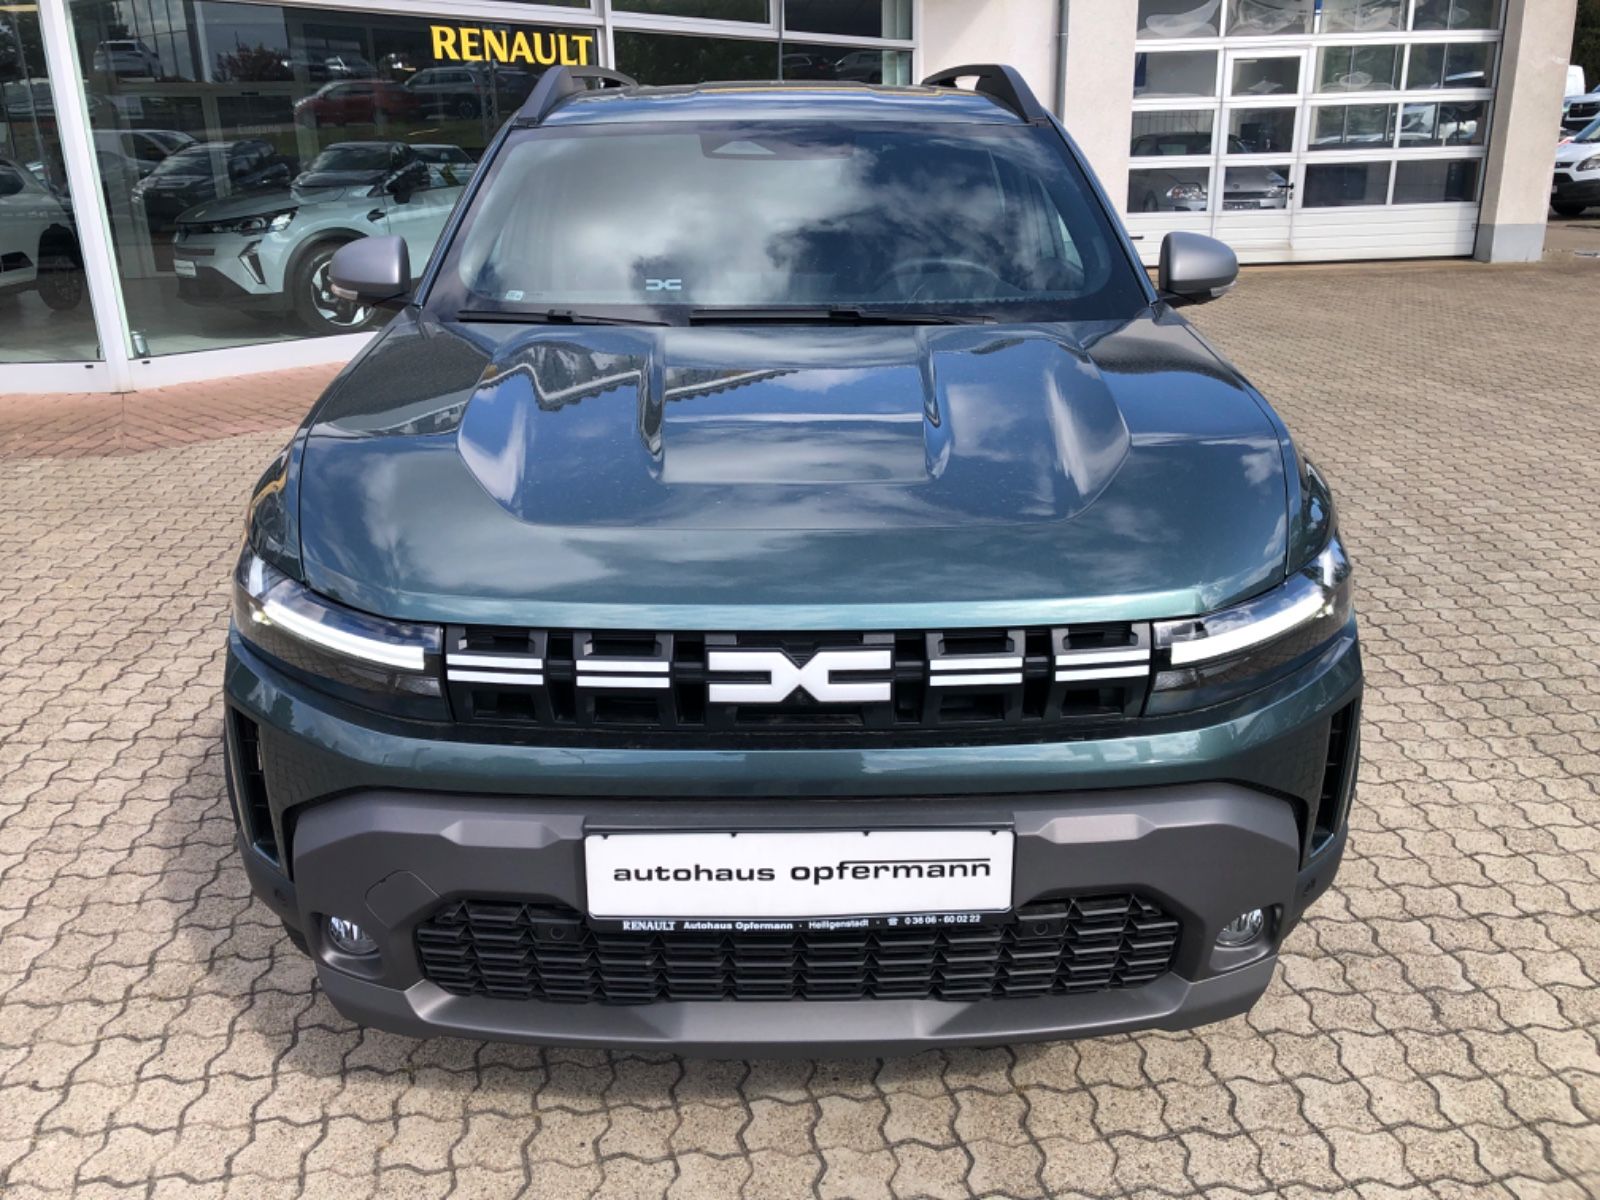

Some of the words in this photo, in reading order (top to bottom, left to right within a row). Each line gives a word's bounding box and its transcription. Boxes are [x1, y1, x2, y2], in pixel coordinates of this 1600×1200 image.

[430, 25, 593, 66] RENAULT
[613, 864, 776, 882] autohaus
[790, 858, 991, 885] opfermann
[622, 920, 676, 931] RENAULT
[683, 921, 733, 930] Autohaus
[735, 921, 794, 932] Opfermann
[808, 918, 869, 930] Heiligenstadt
